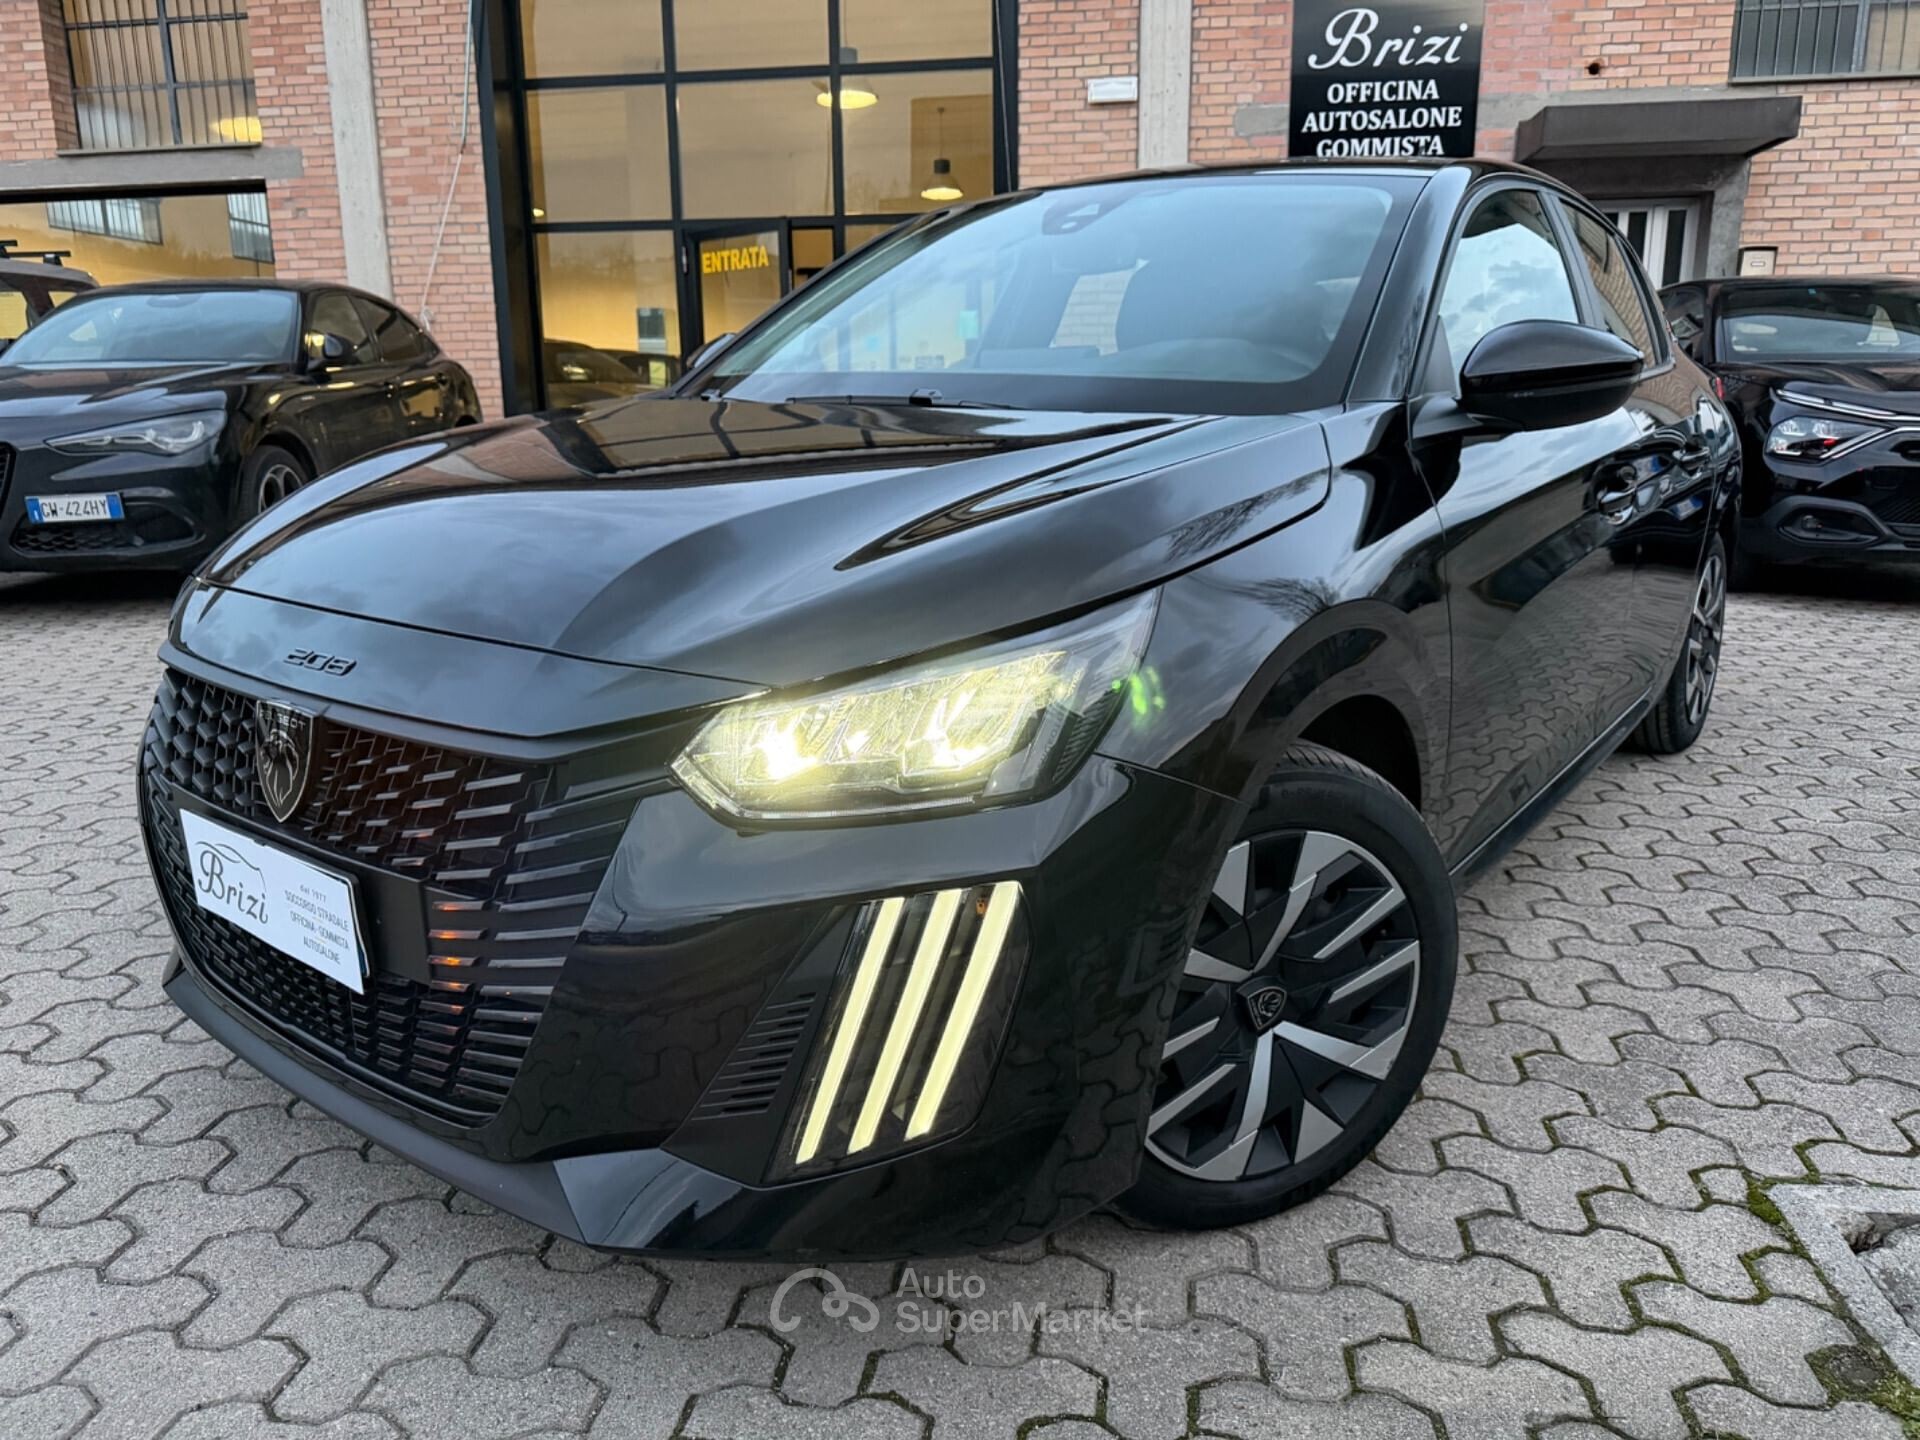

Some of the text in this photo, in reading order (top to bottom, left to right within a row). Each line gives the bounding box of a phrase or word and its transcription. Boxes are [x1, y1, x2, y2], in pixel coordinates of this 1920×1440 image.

[1308, 8, 1468, 69] Brizi
[1327, 79, 1440, 104] OFFICINA
[1302, 106, 1463, 133] AUTOSALONE
[1316, 135, 1445, 157] GOMMISTA
[702, 246, 769, 274] ENTRATA
[65, 500, 107, 517] 424HY
[283, 648, 358, 677] 208
[259, 710, 306, 731] PEGEOT
[198, 849, 269, 924] Brizi
[284, 890, 349, 932] SOCCORSO STRADALE
[290, 910, 314, 931] OFFICINA
